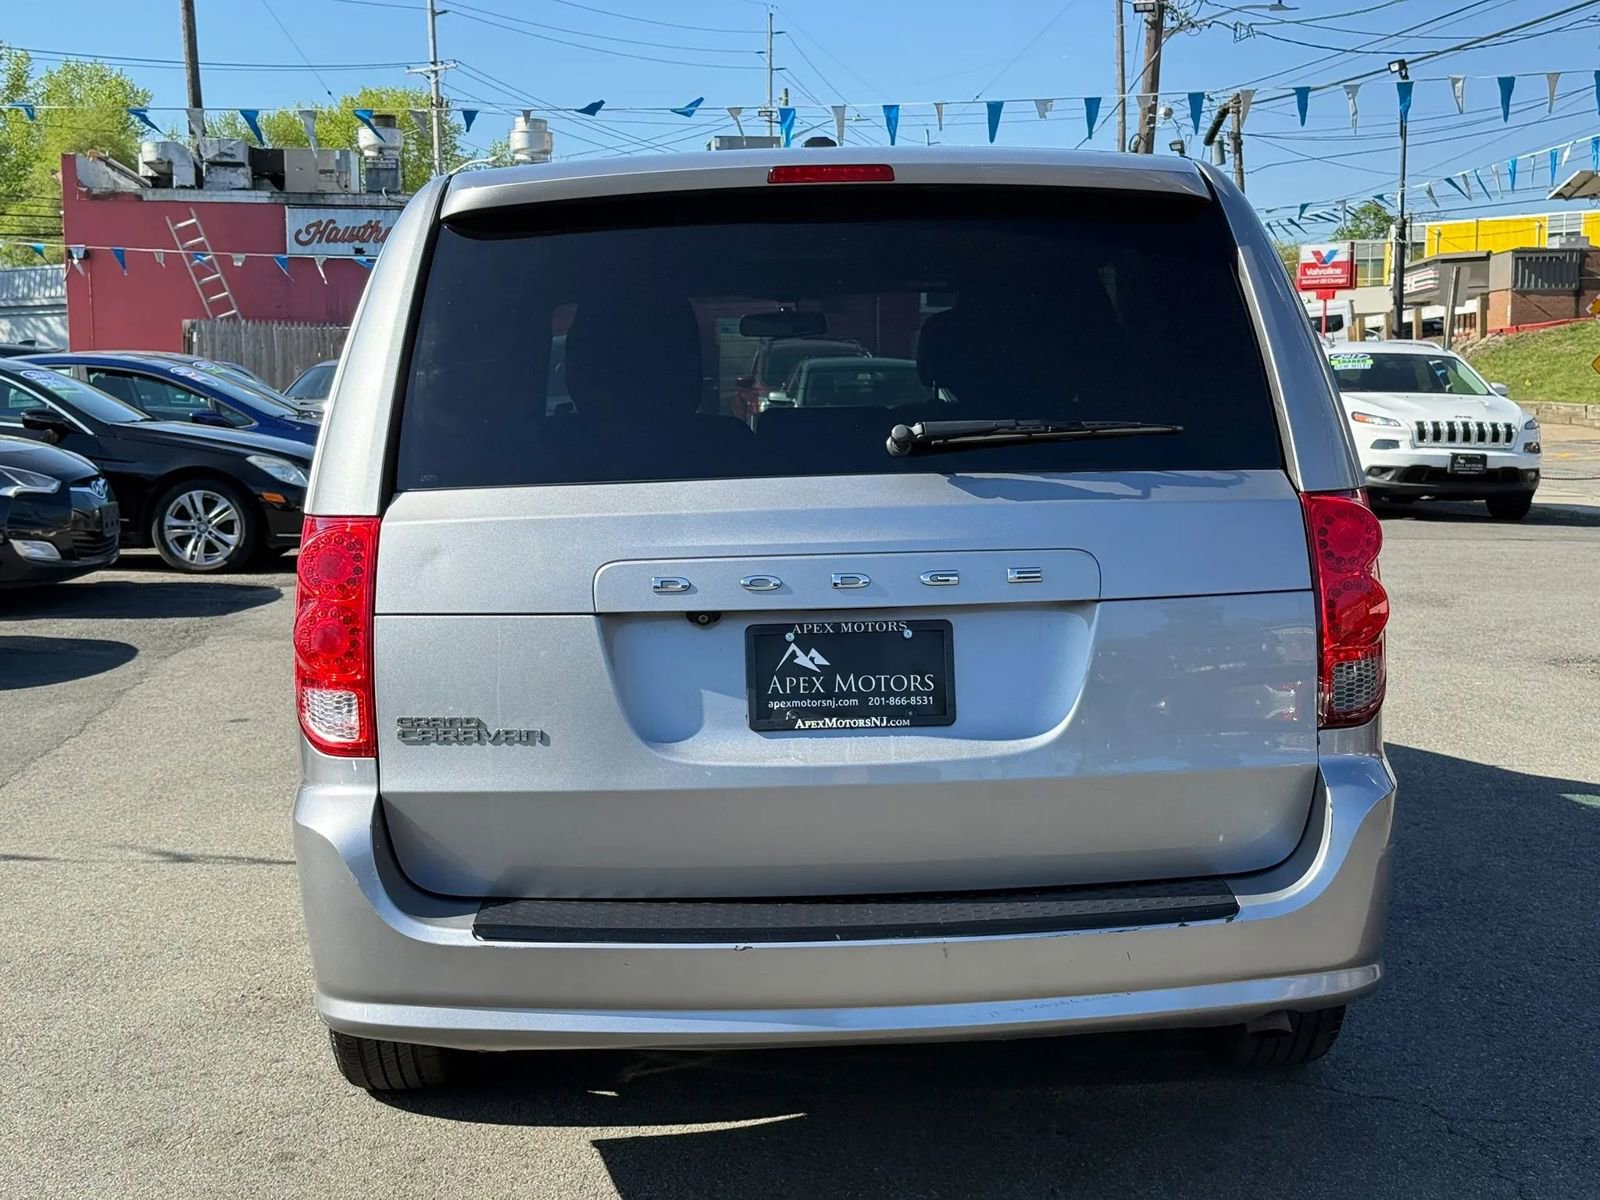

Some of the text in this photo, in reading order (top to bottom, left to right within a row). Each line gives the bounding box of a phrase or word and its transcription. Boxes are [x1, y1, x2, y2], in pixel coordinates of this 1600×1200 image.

[1305, 267, 1342, 276] Valvoline
[651, 567, 1043, 592] DODGE
[792, 620, 908, 635] APEX MOTORS
[766, 672, 935, 695] APEX MOTORS
[767, 696, 934, 709] apexmotorsnj.com 201-866-8531
[396, 715, 481, 728] GRAND
[396, 727, 550, 746] CARAVAN
